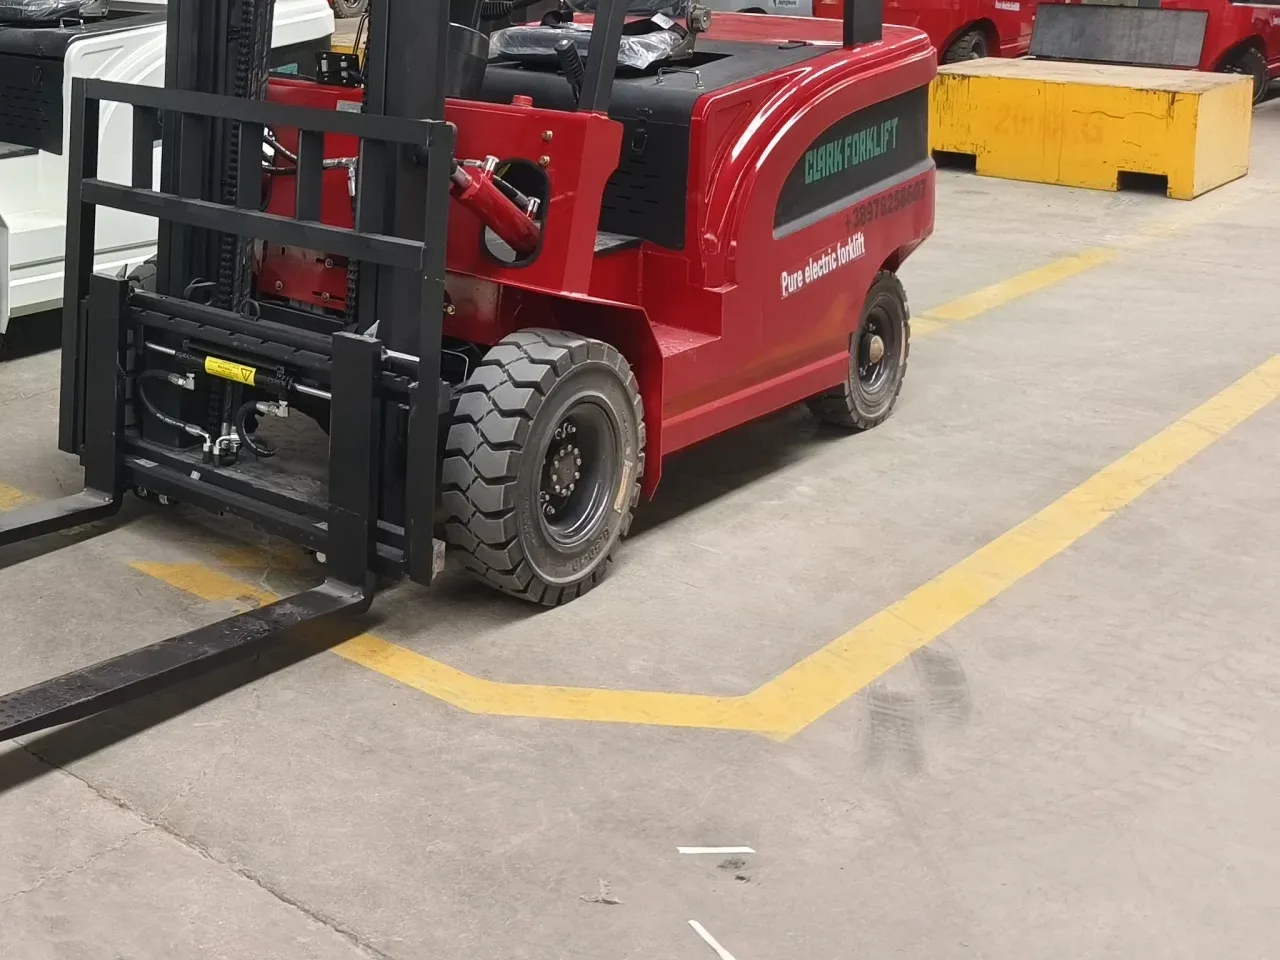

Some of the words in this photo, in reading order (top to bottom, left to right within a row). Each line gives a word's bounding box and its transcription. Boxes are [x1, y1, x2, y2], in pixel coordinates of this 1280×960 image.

[804, 139, 843, 185] CLARK
[844, 117, 899, 169] FORKLIFT
[780, 269, 804, 297] Pure
[804, 247, 838, 285] electric
[837, 230, 866, 267] forklift
